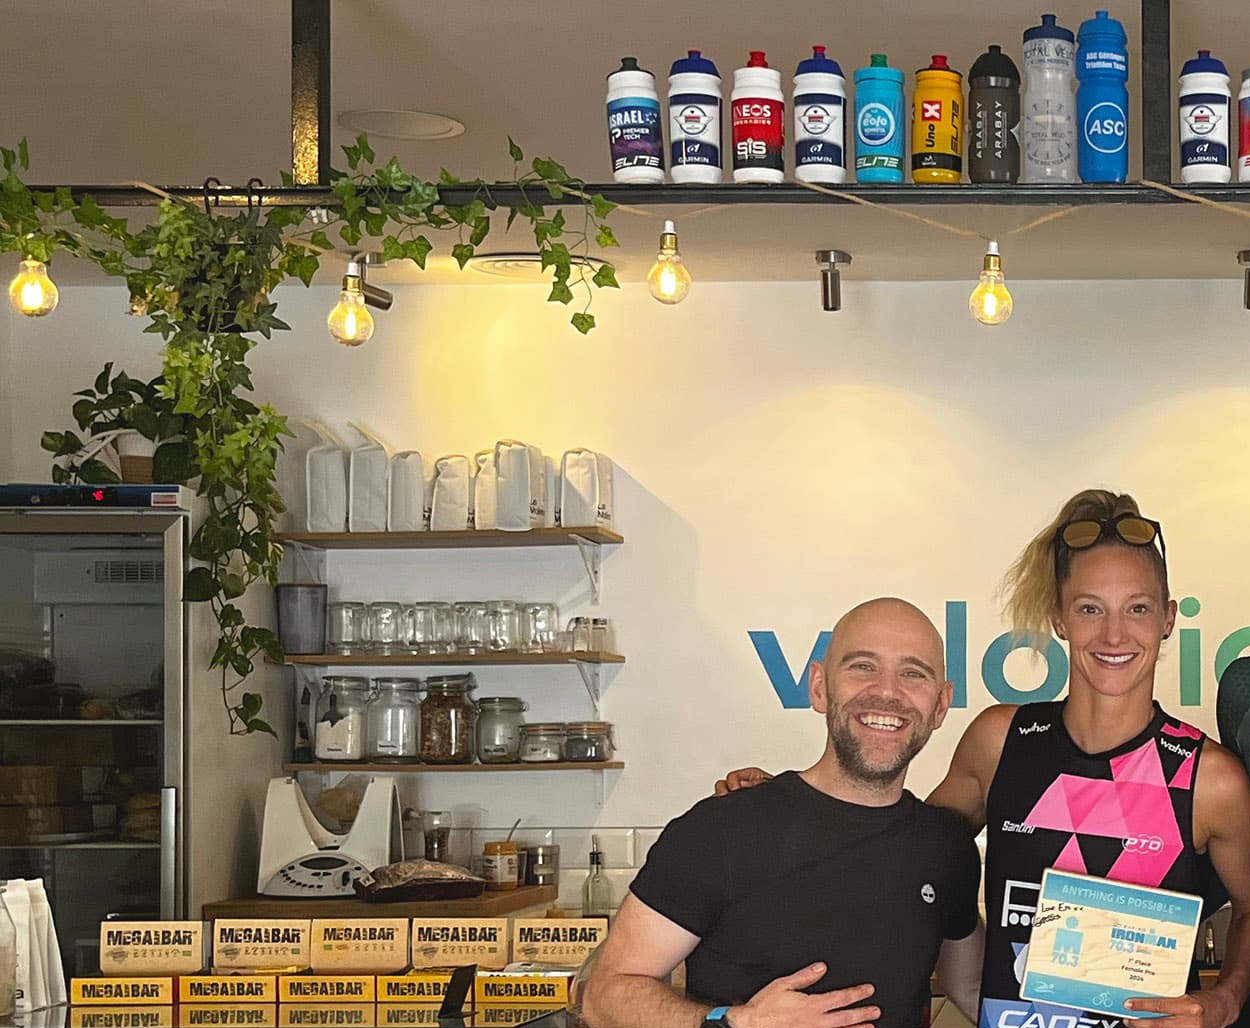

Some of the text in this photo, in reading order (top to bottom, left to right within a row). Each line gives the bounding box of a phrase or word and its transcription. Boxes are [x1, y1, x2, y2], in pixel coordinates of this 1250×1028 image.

[608, 110, 645, 128] ISRAEL
[925, 124, 935, 147] Uno
[1088, 119, 1124, 137] ASC
[678, 156, 709, 164] GARMIN
[801, 156, 833, 164] GARMIN
[1187, 155, 1218, 164] GARMIN
[1002, 820, 1036, 834] Santini
[1125, 836, 1162, 851] PTO
[1062, 884, 1176, 914] ANYTHING IS POSSIBLE
[1111, 927, 1177, 950] IRONMAN
[1110, 940, 1134, 954] 70.3
[1050, 951, 1080, 968] 70.3
[1121, 965, 1144, 974] Female
